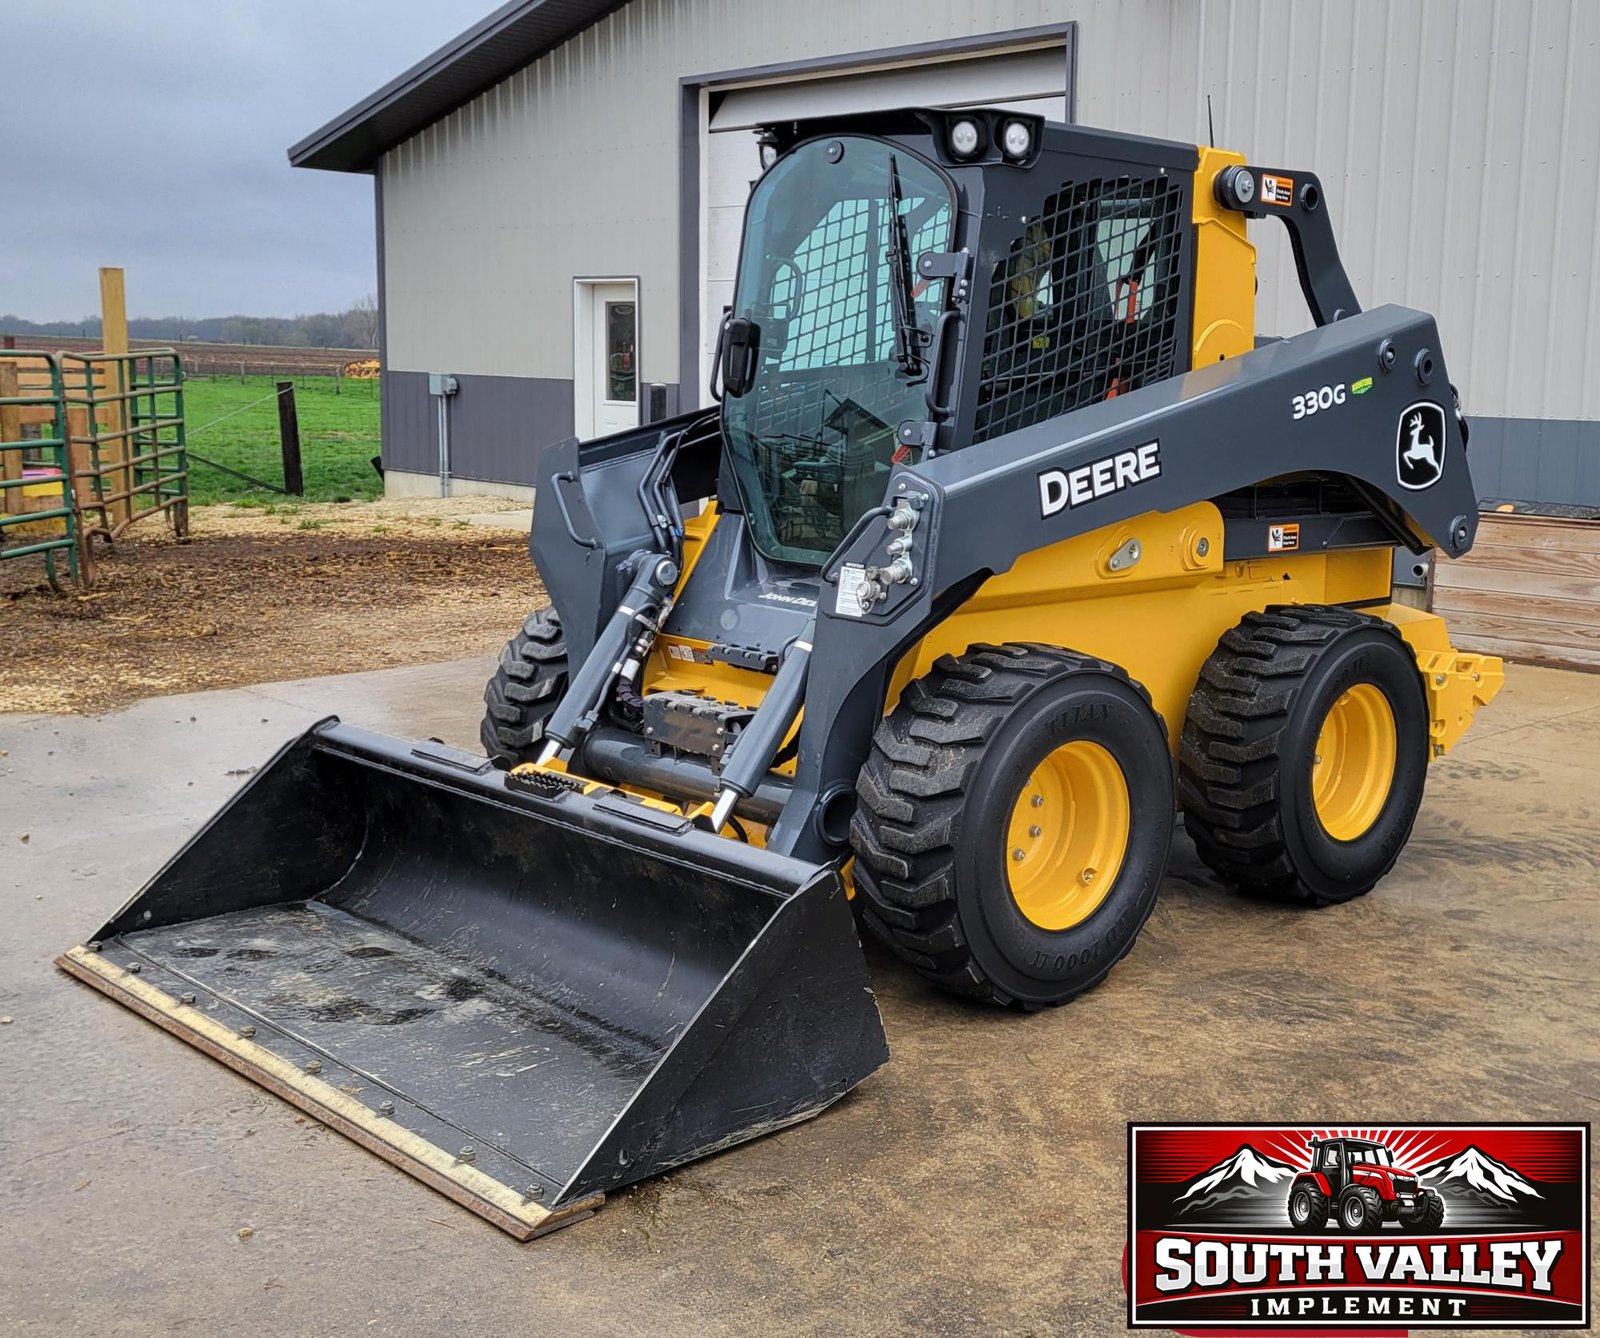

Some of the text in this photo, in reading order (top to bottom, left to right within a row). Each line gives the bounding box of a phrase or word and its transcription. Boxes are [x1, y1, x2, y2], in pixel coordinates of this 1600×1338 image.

[1292, 383, 1346, 420] 330G
[1040, 443, 1160, 516] DEERE
[758, 592, 795, 602] JOHN
